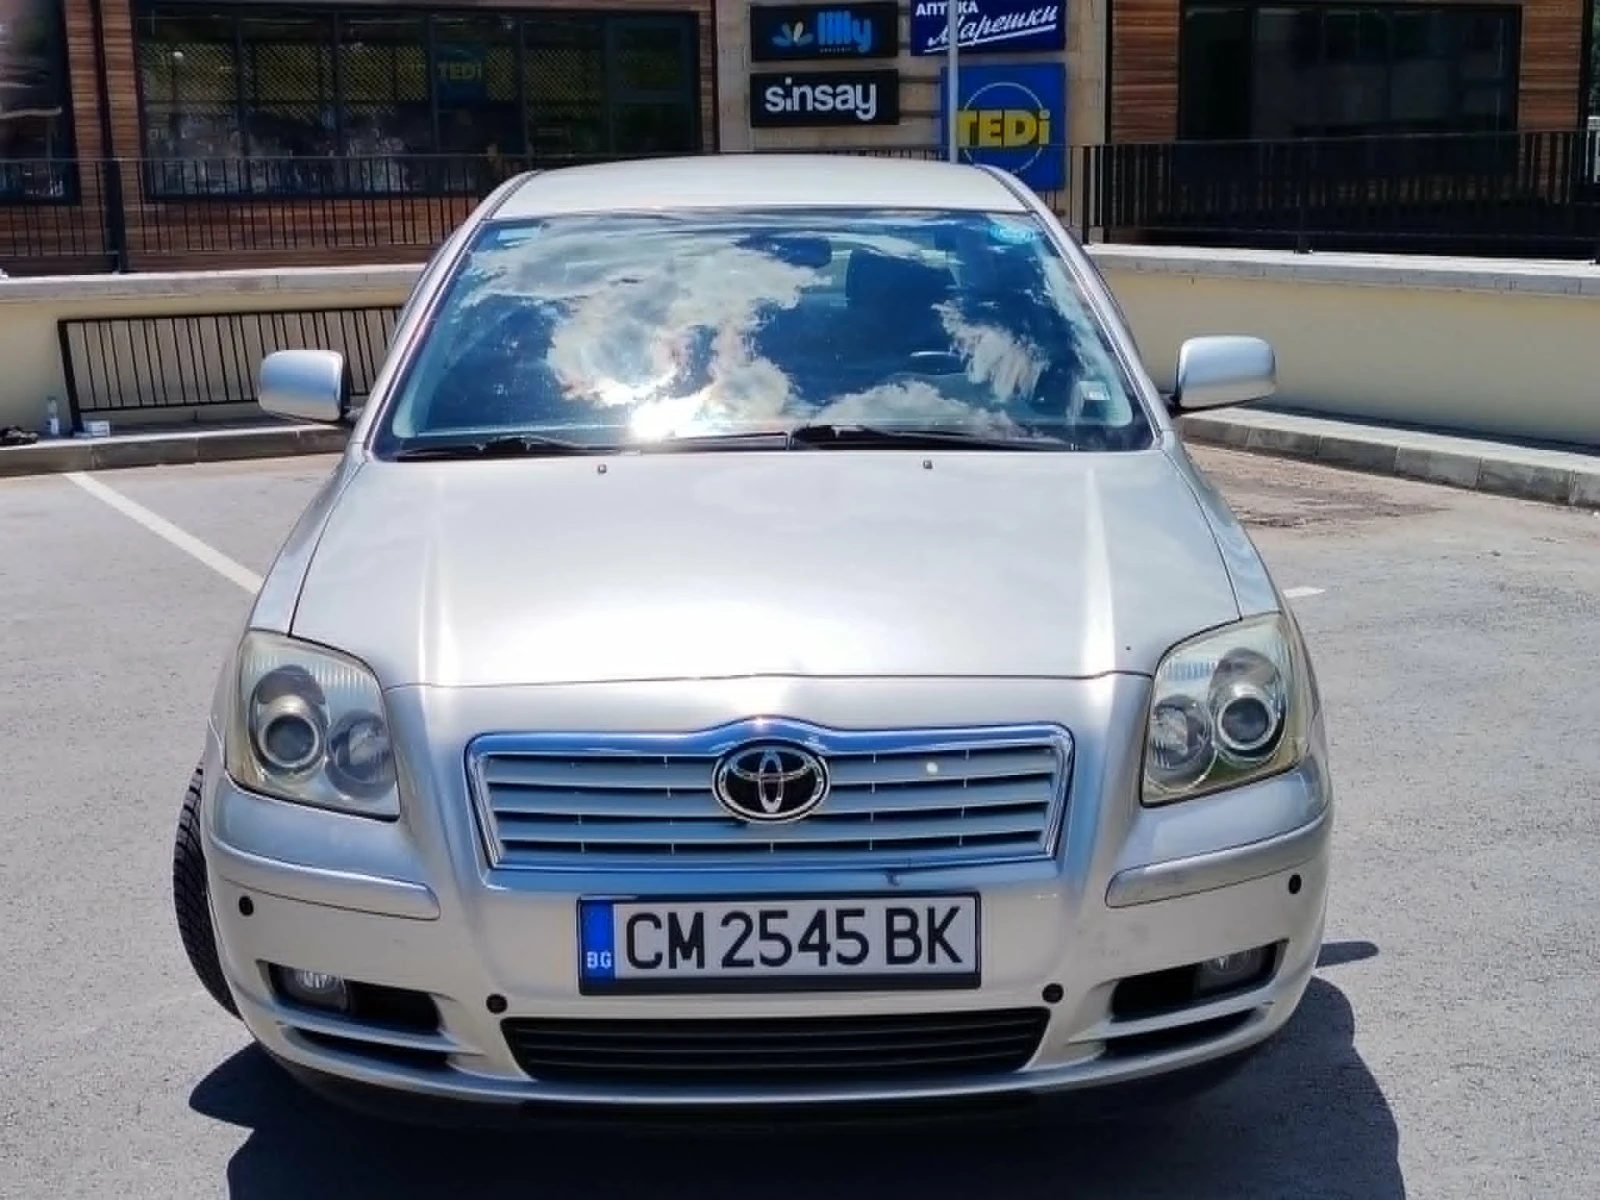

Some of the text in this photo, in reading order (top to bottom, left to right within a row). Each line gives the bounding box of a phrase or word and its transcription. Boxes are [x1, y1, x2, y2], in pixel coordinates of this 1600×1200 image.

[915, 0, 979, 16] АПТКА
[818, 10, 872, 53] lilly
[764, 76, 877, 121] sinsay
[625, 905, 963, 970] CM 2545 BK
[587, 950, 612, 969] BG
